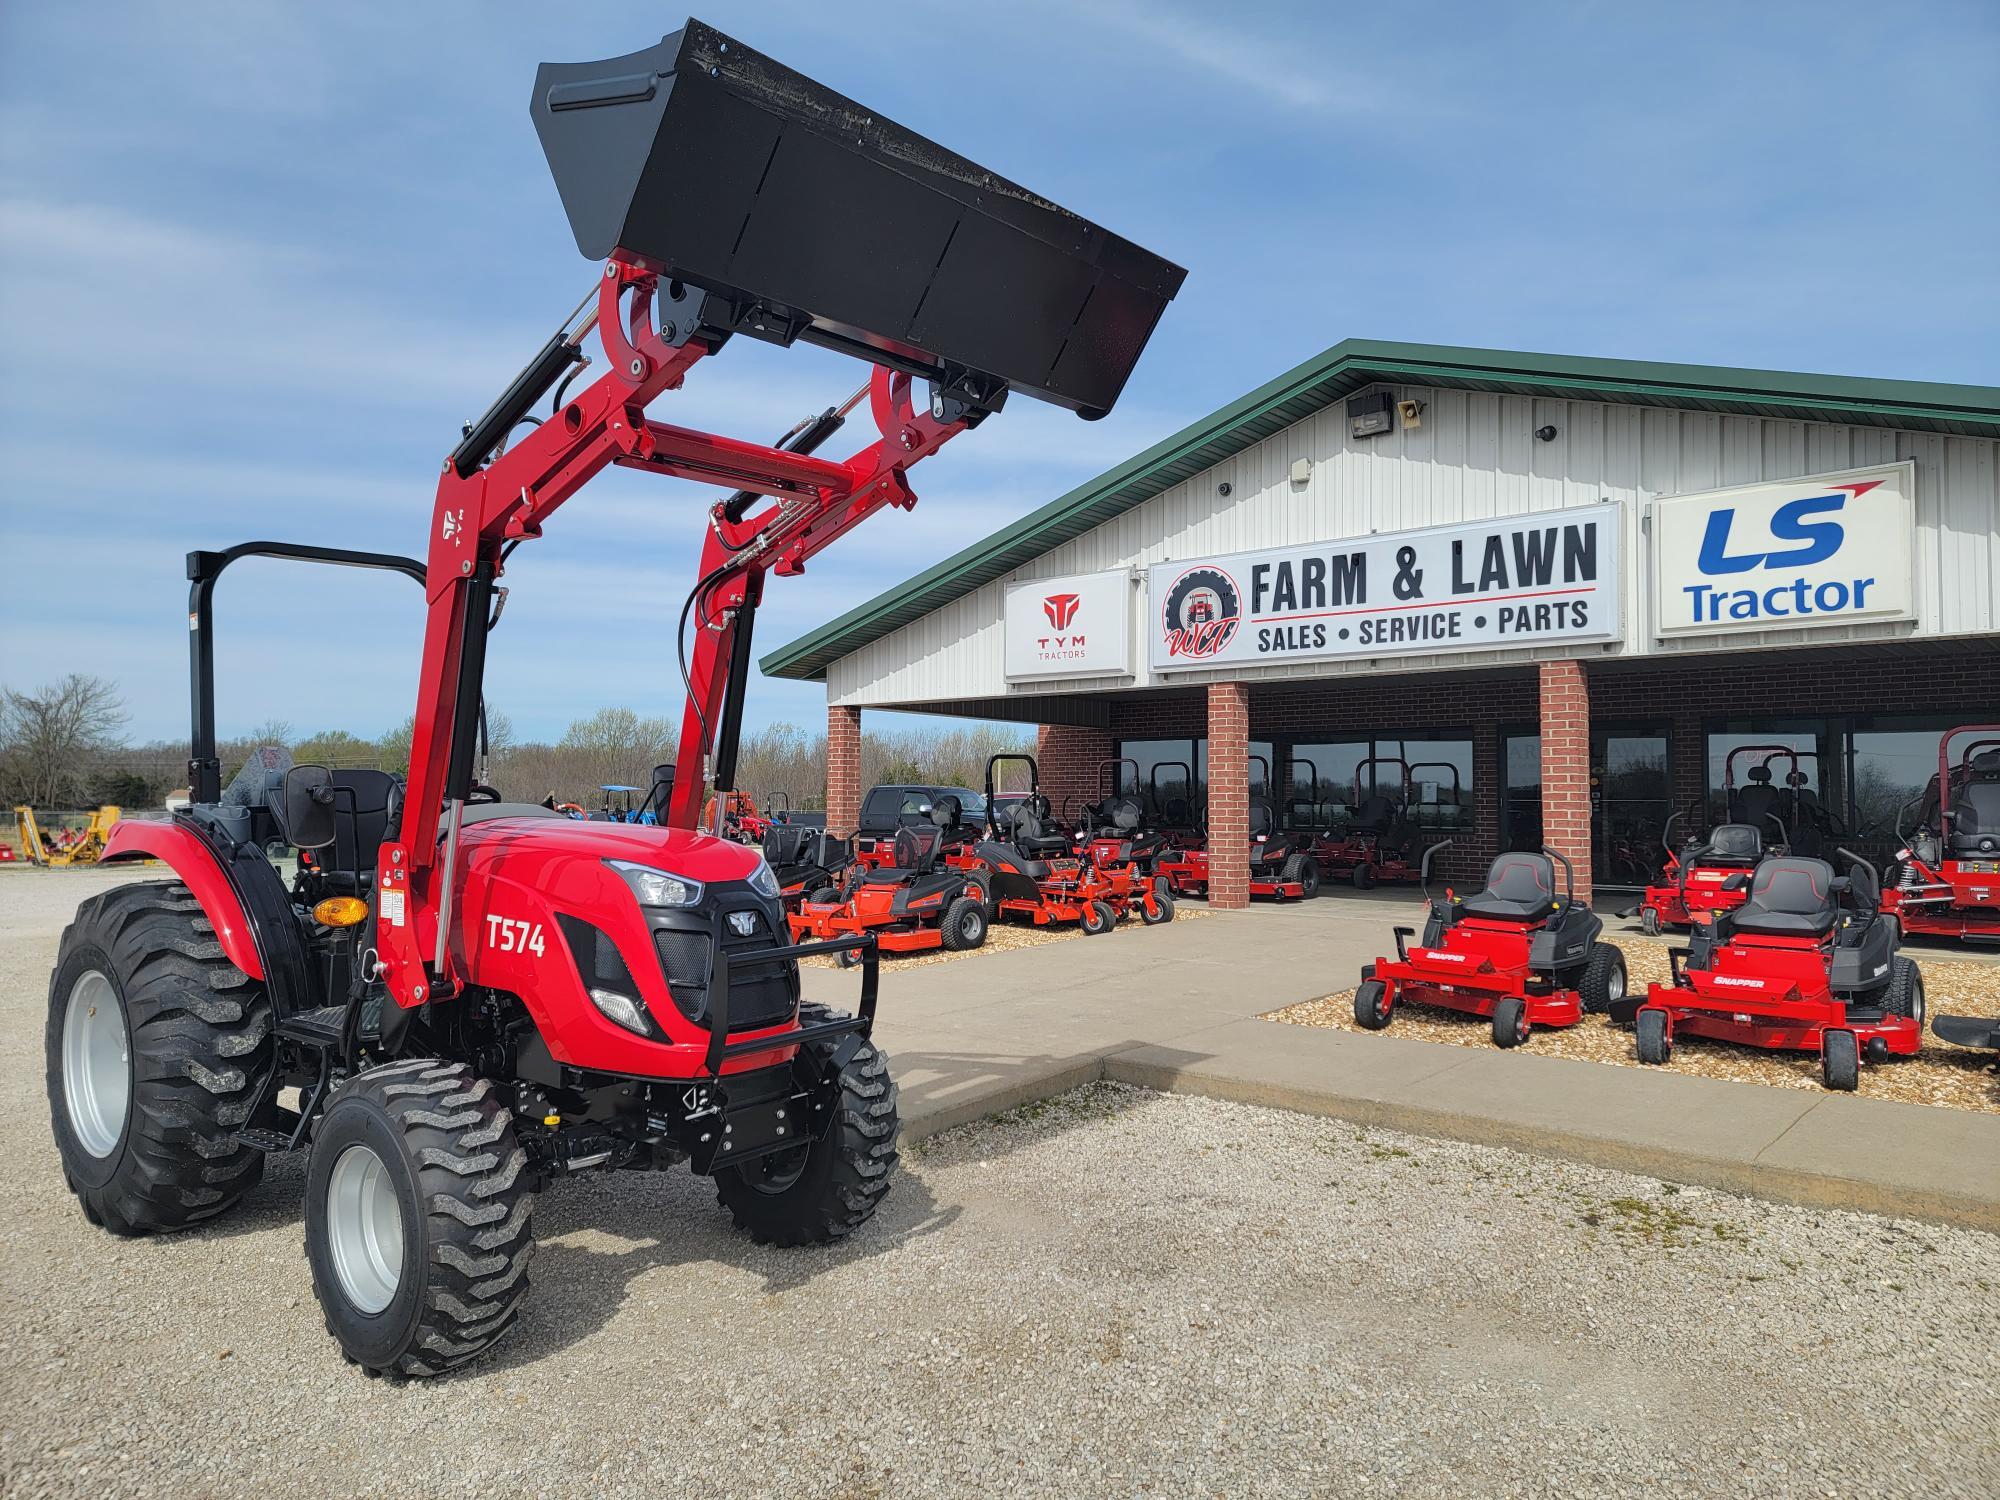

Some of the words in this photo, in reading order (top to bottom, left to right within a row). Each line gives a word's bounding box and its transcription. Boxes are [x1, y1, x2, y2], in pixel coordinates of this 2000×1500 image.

[1698, 493, 1847, 576] LS
[1251, 551, 1367, 614] FARM
[1392, 545, 1424, 601] &
[1451, 522, 1597, 595] LAWN
[1683, 577, 1875, 622] Tractor
[1037, 635, 1086, 649] TYM
[1164, 617, 1240, 657] WCT
[1258, 623, 1327, 652] SALES
[1359, 611, 1461, 645] SERVICE
[1499, 600, 1588, 634] PARTS
[1039, 649, 1086, 661] TRACTORS
[487, 914, 545, 958] T574
[1426, 952, 1466, 962] SNAPPER
[1713, 976, 1765, 988] SNAPPER
